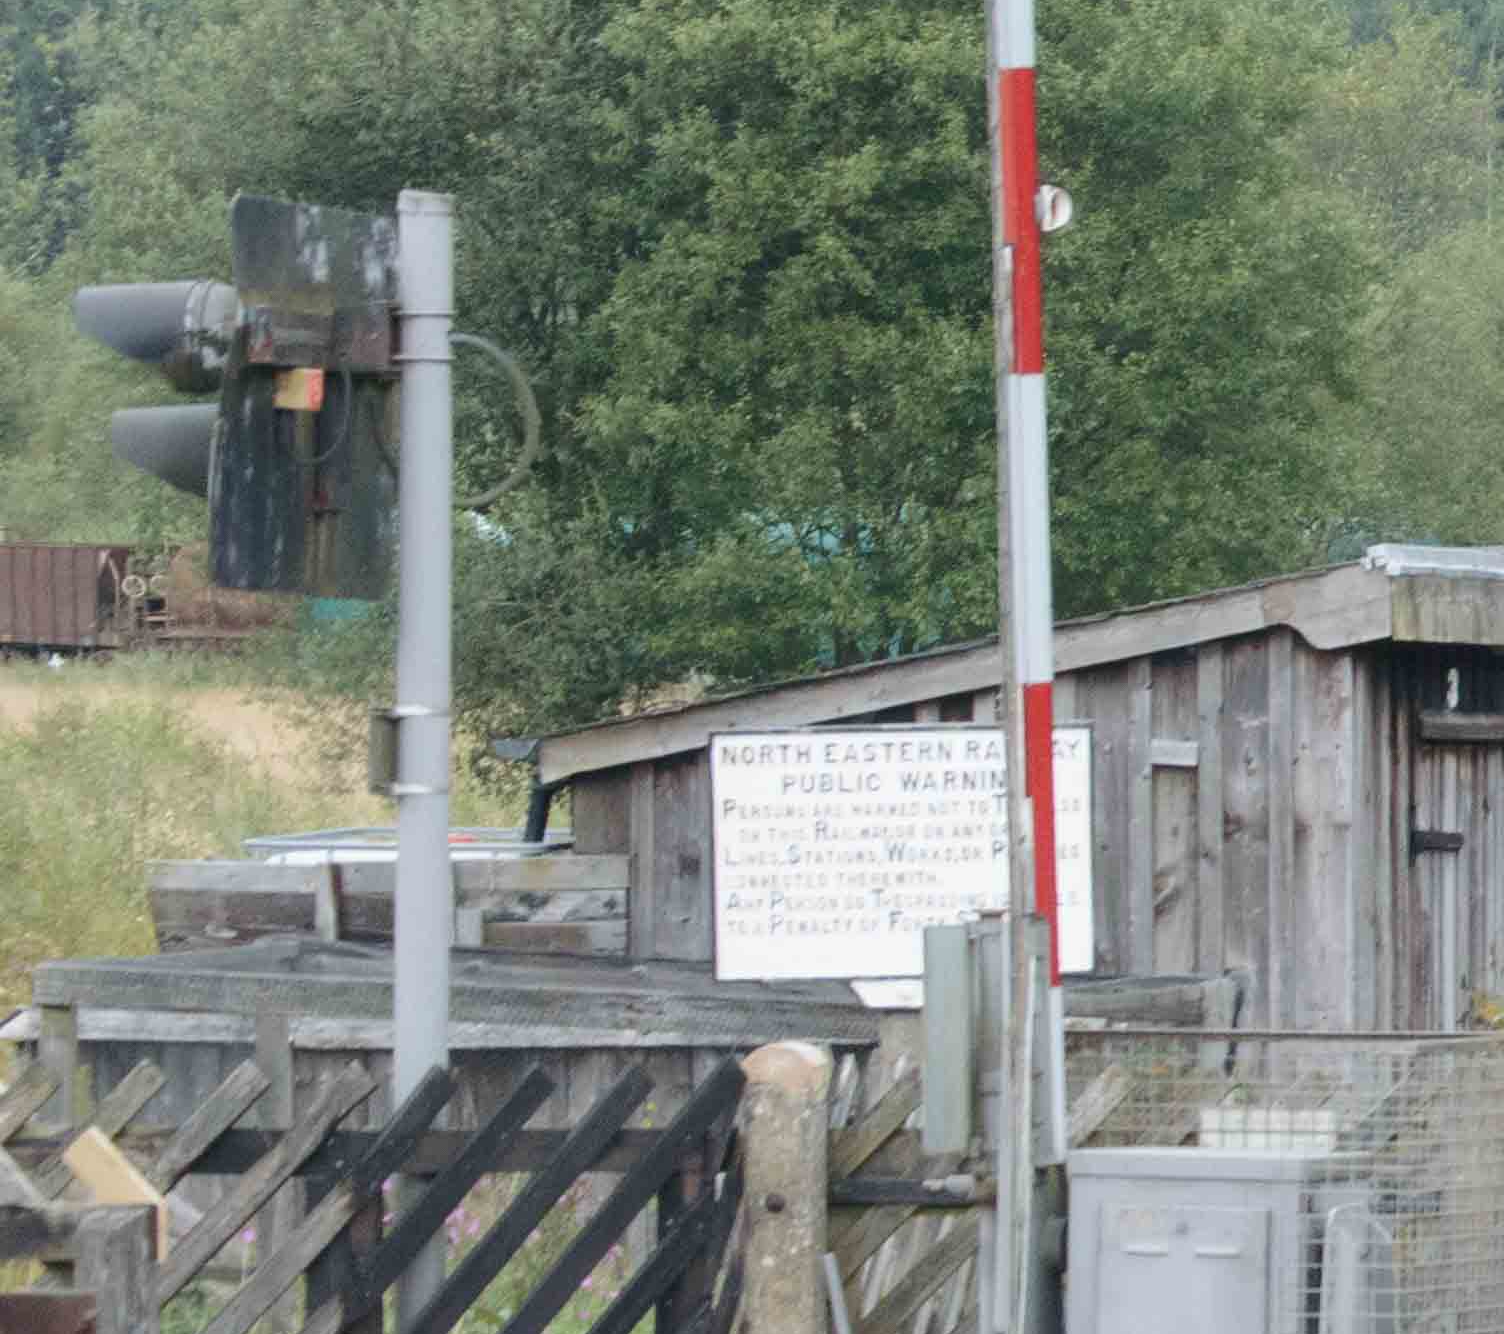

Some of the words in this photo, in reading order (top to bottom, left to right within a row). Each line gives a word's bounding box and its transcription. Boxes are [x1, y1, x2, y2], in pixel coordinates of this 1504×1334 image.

[721, 743, 812, 765] NORTH
[824, 740, 953, 764] EASTERN
[782, 772, 881, 794] PUBLIC
[902, 770, 1008, 791] WARNIN
